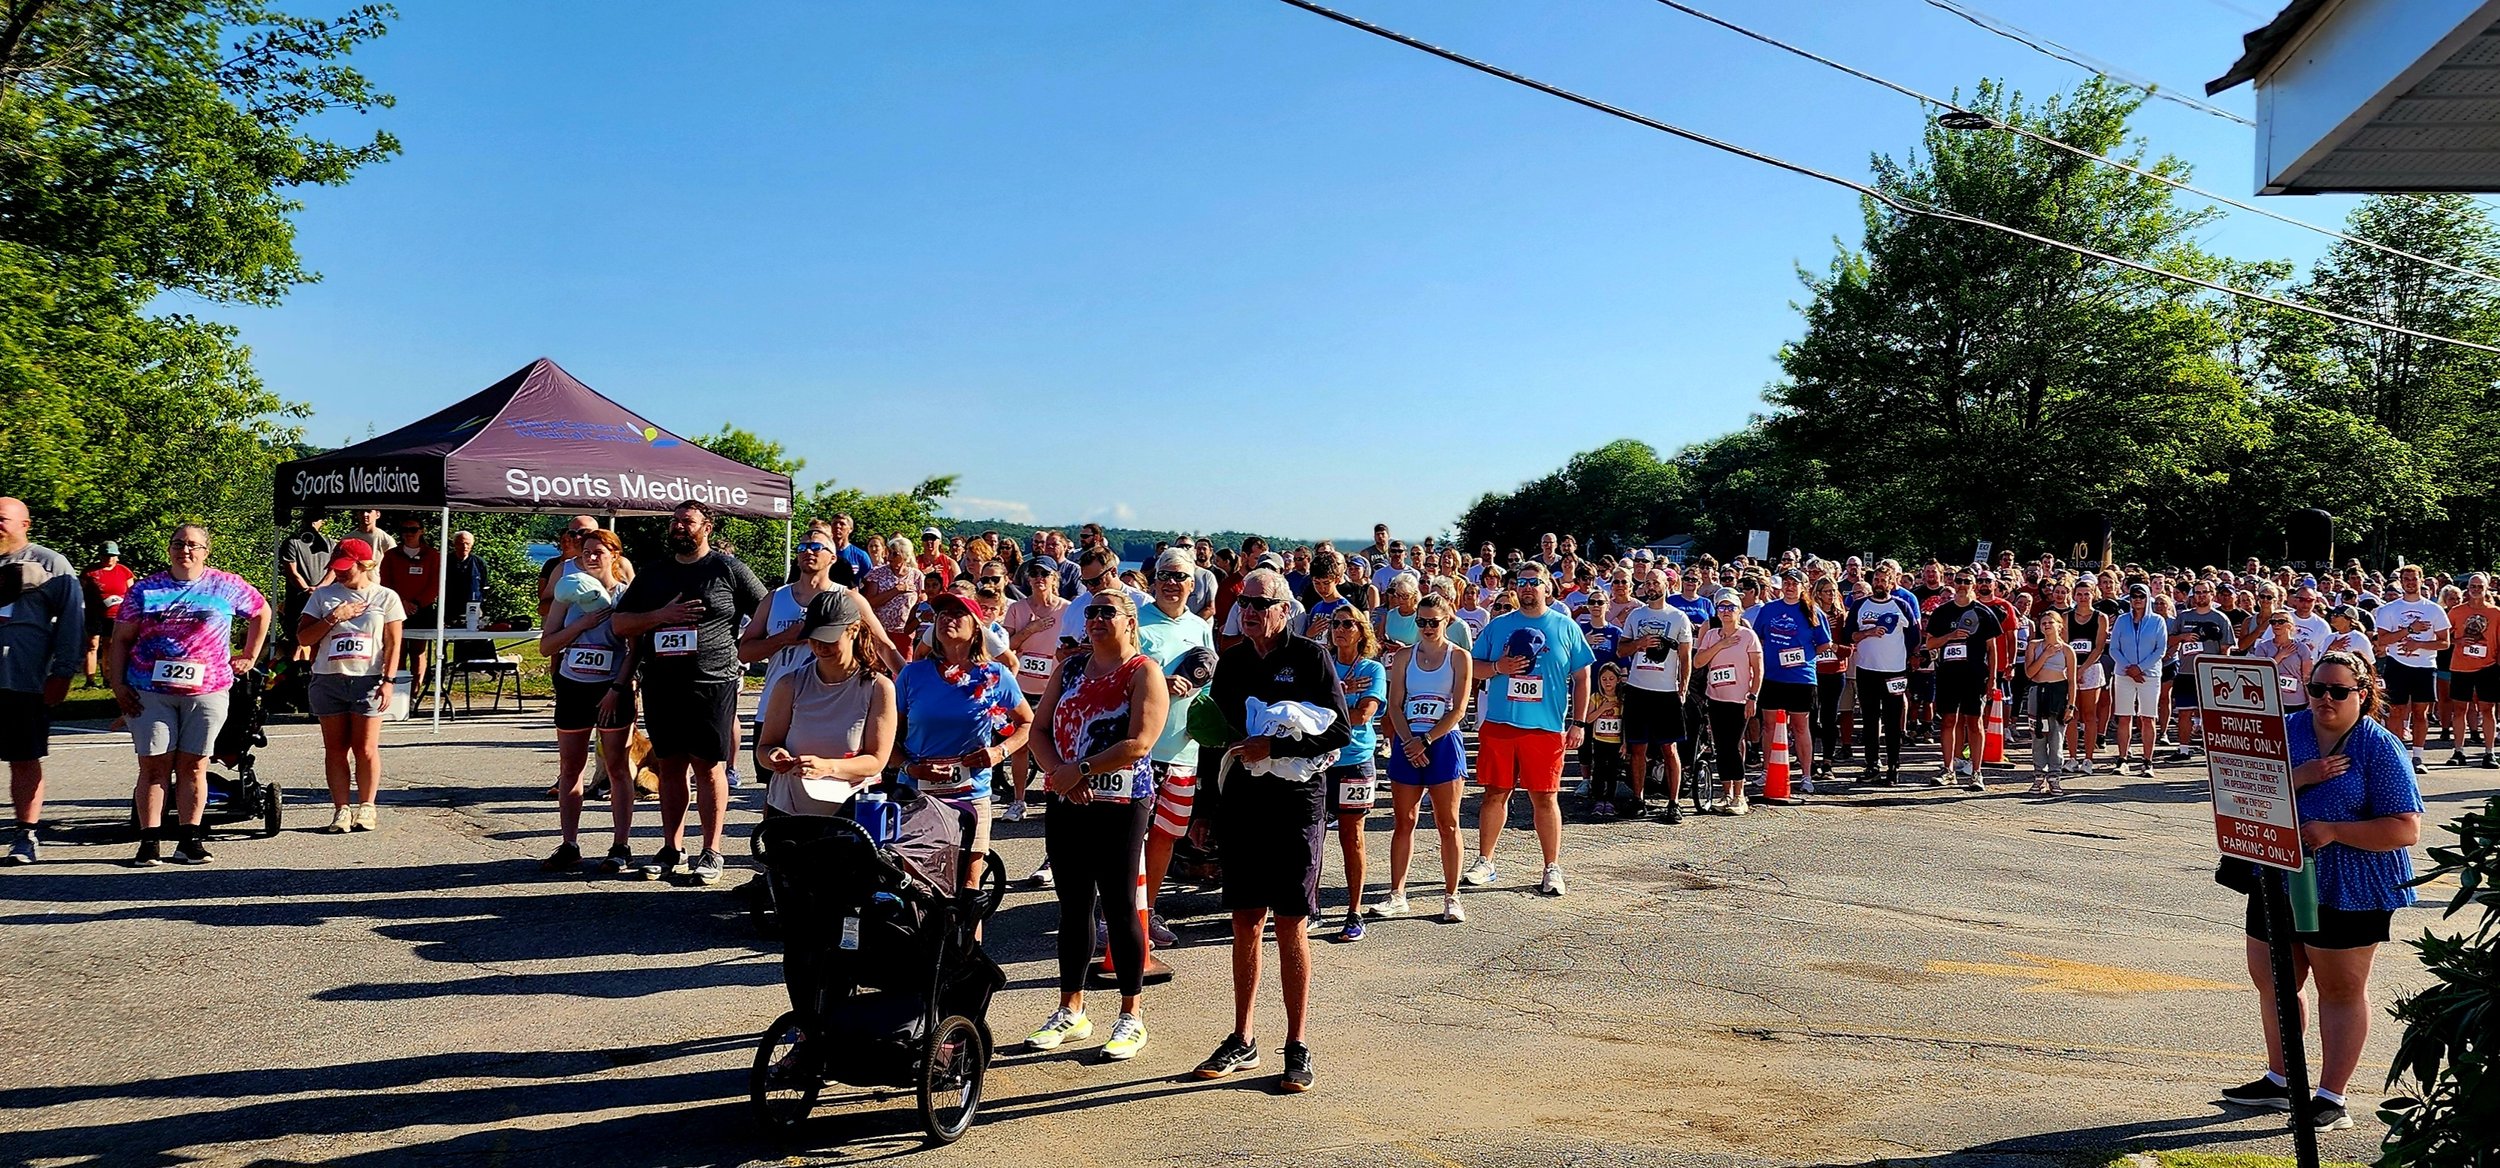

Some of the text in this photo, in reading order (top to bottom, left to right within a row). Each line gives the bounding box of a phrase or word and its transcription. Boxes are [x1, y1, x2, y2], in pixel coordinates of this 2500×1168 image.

[515, 428, 641, 444] Medical Center
[292, 466, 420, 501] Sports Medicine
[506, 468, 749, 505] Sports Medicine
[336, 639, 364, 652] 605
[661, 633, 687, 648] 251
[2073, 642, 2088, 650] 209
[575, 651, 605, 666] 250
[1023, 658, 1046, 671] 353
[1784, 652, 1801, 663] 156
[161, 664, 195, 680] 329
[1713, 670, 1730, 681] 315
[1514, 681, 1537, 695] 308
[1412, 702, 1438, 715] 367
[1600, 720, 1618, 731] 314
[2220, 716, 2264, 734] PRIVATE
[2207, 732, 2282, 755] PARKING ONLY
[2244, 760, 2265, 771] VEHICLES
[2277, 764, 2285, 774] BE
[1088, 771, 1123, 791] 309
[2240, 770, 2259, 781] VEHICLE
[1346, 786, 1371, 801] 237
[2234, 821, 2277, 842] POST 40
[2222, 835, 2296, 863] PARKING ONLY
